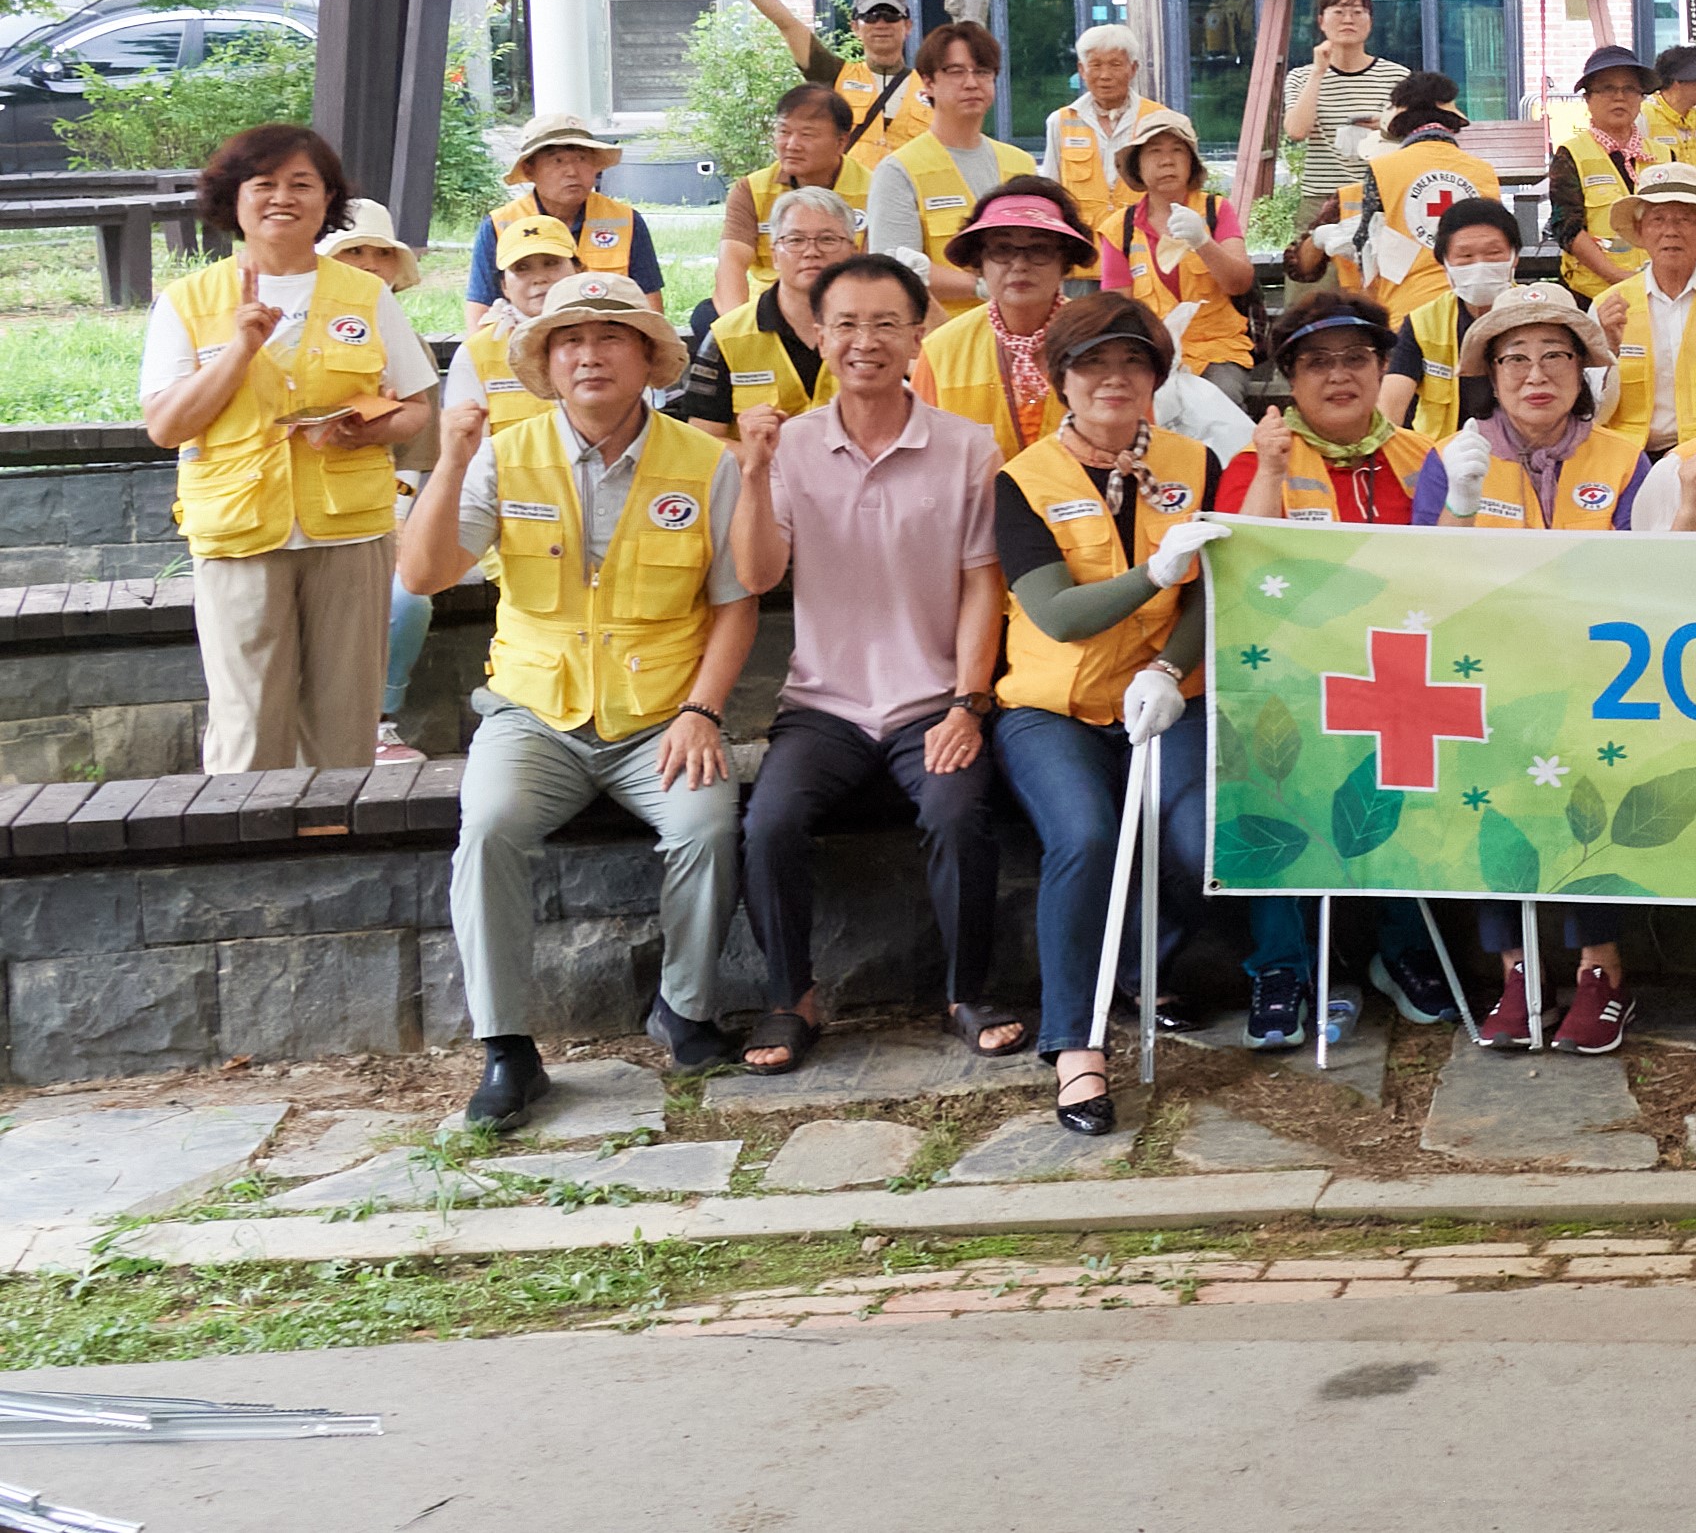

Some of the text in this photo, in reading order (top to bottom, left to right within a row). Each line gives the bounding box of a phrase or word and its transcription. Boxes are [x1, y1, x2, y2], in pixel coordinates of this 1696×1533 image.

[1410, 172, 1478, 200] KOREAN RED CROS
